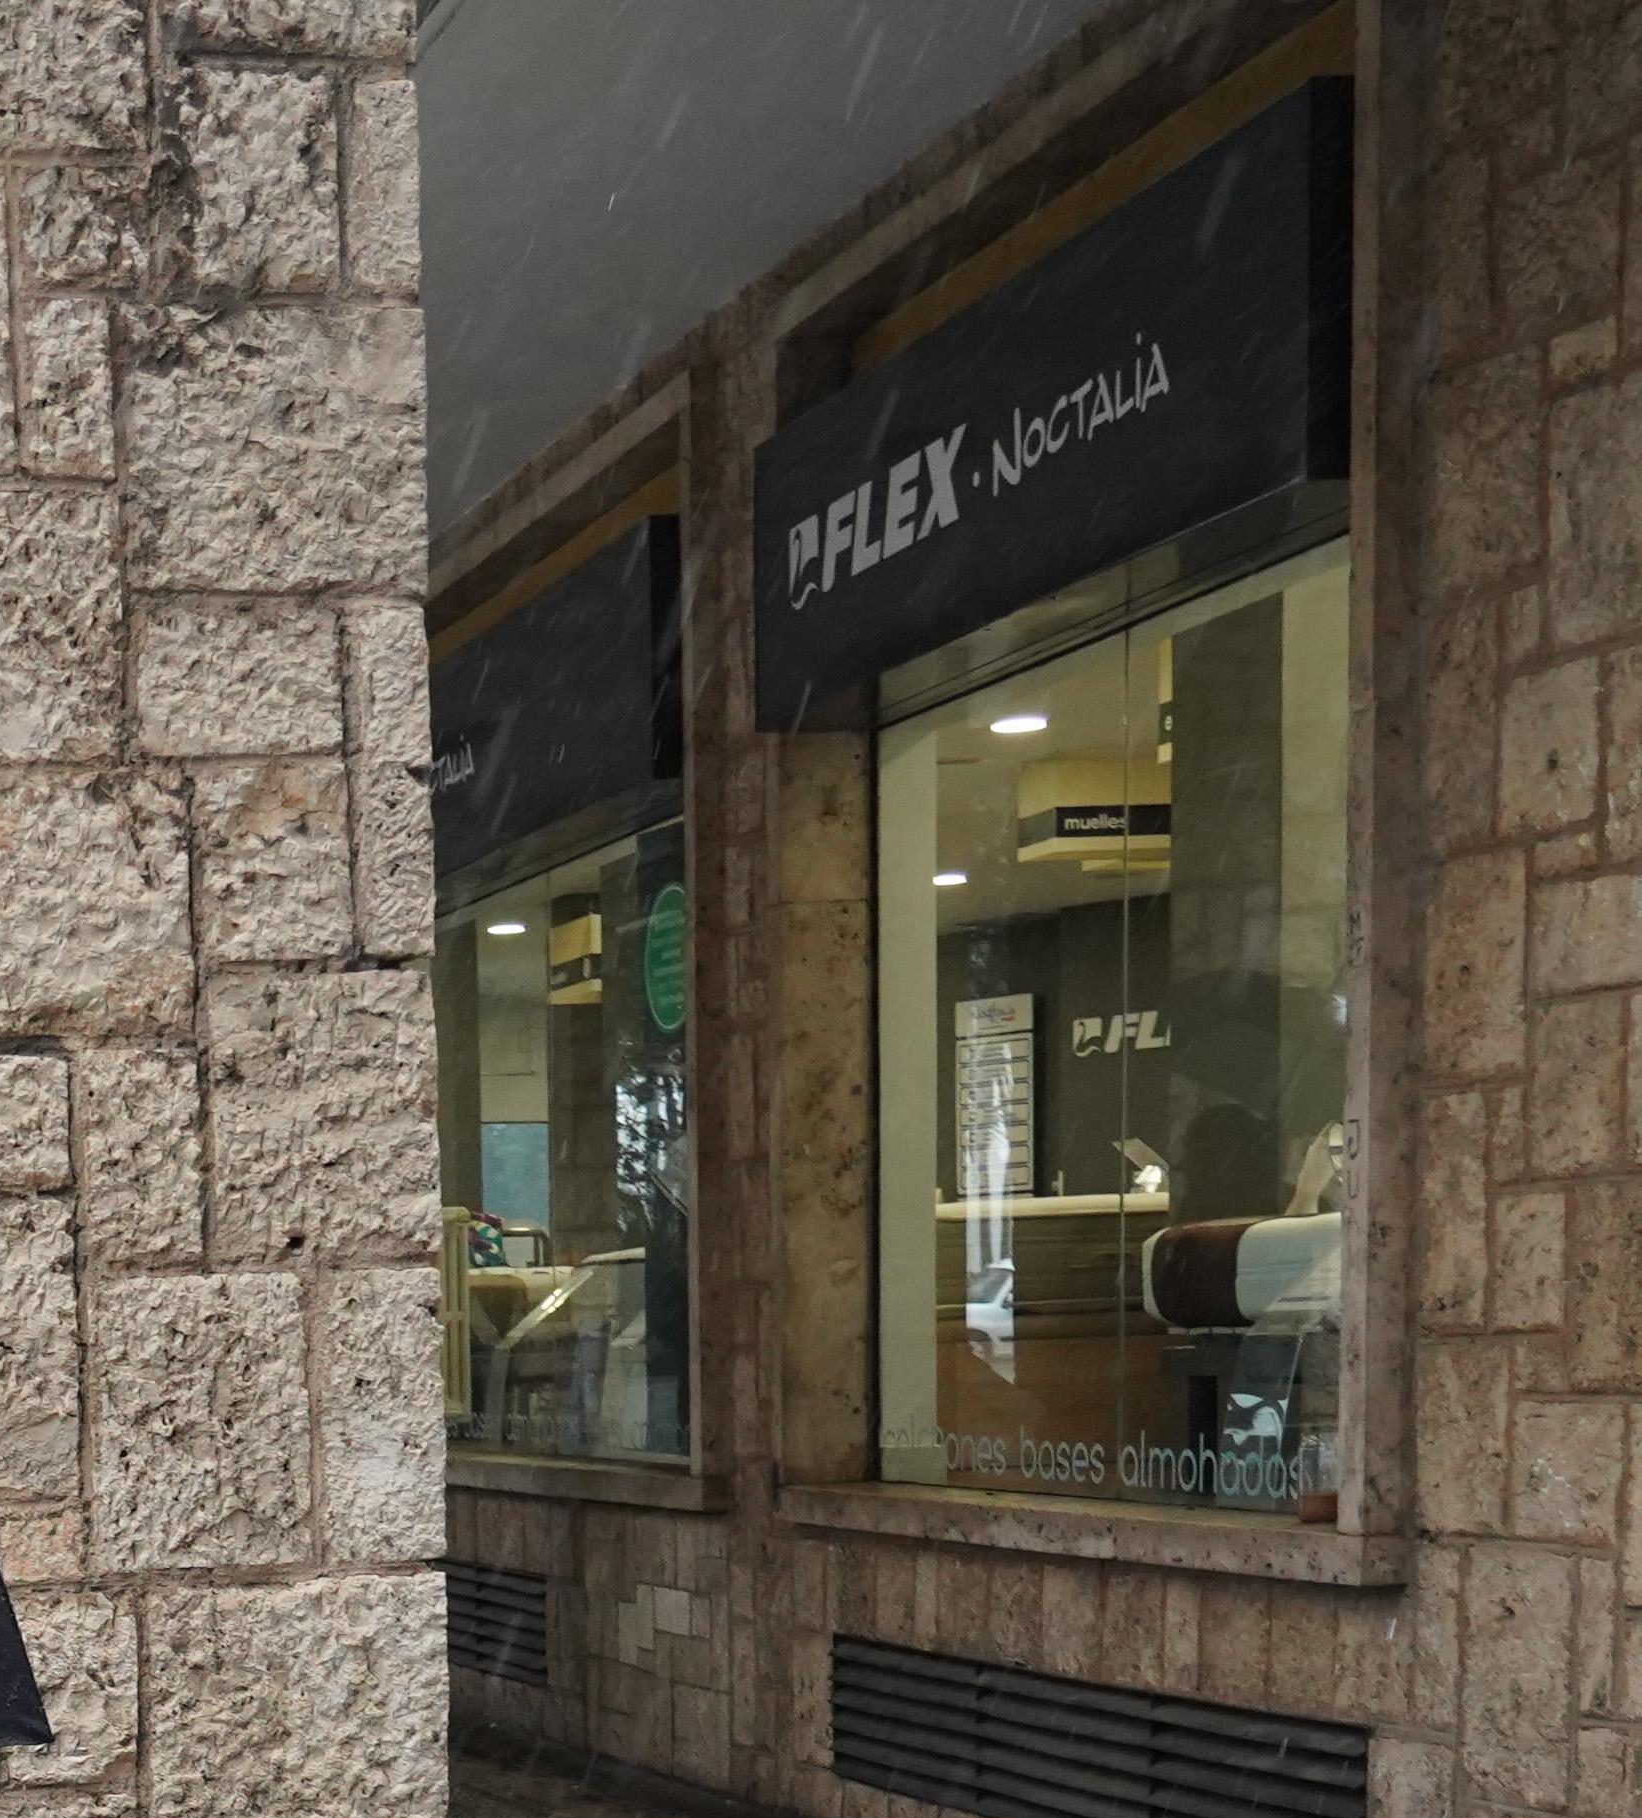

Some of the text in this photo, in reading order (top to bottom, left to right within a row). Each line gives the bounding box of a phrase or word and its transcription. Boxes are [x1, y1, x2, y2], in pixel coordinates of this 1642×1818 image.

[820, 423, 969, 593] FLEX
[1064, 813, 1129, 831] muelles
[1104, 1010, 1171, 1054] FL
[1020, 1426, 1106, 1485] bases
[1120, 1430, 1300, 1500] almohadas
